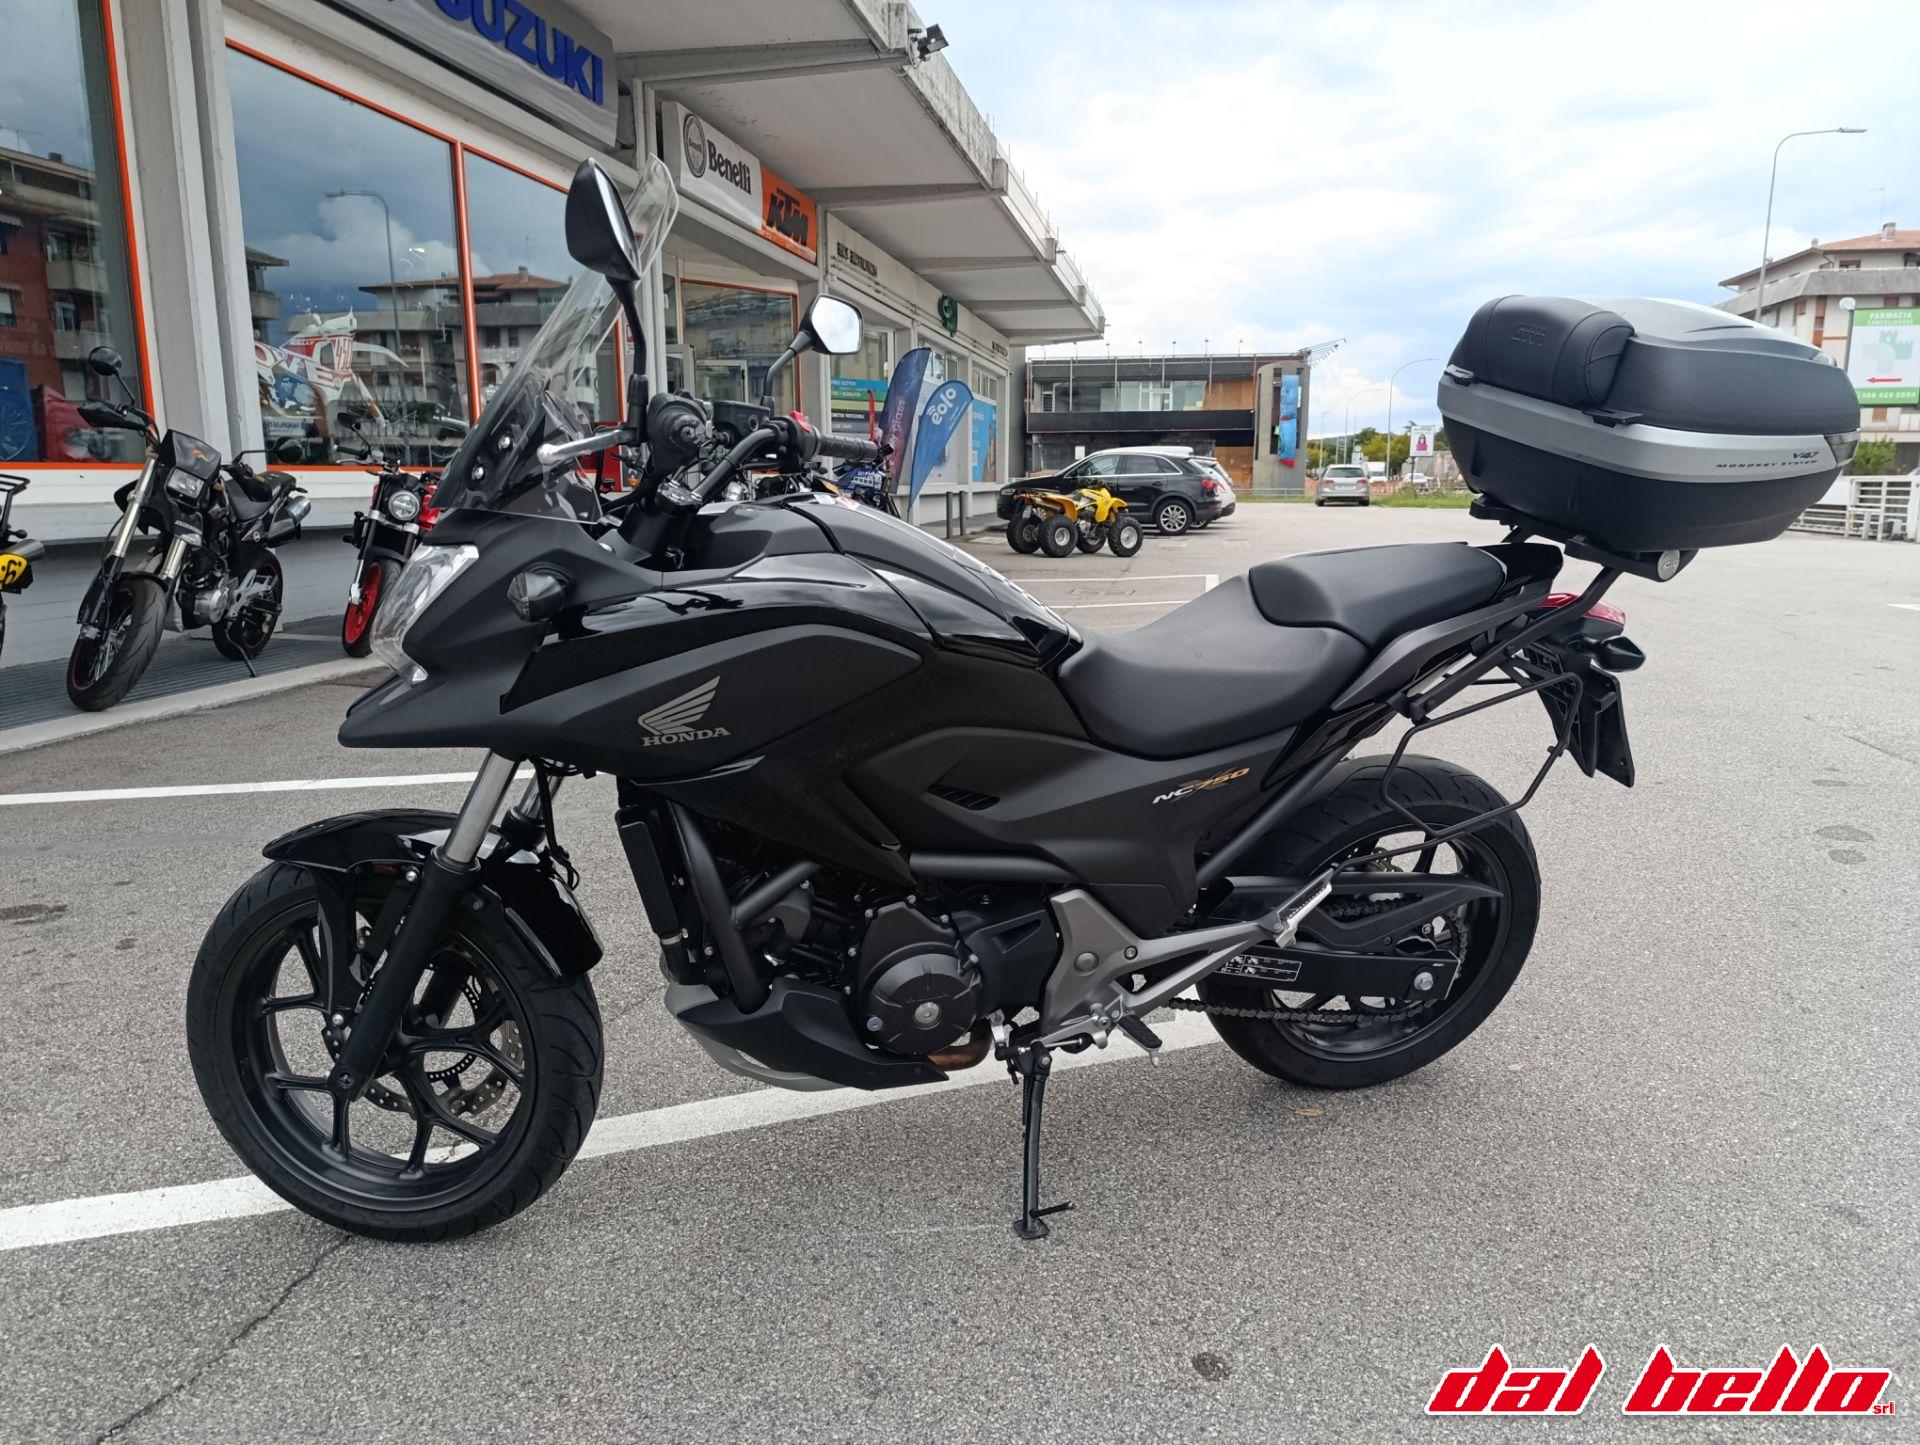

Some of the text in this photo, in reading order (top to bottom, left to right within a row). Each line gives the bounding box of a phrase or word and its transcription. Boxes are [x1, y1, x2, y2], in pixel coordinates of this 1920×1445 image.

[706, 139, 752, 195] Benelli
[766, 187, 809, 247] KTM
[1870, 311, 1912, 320] FARMACIA
[929, 387, 957, 426] eolo
[1793, 450, 1820, 459] V47
[641, 727, 731, 747] HONDA
